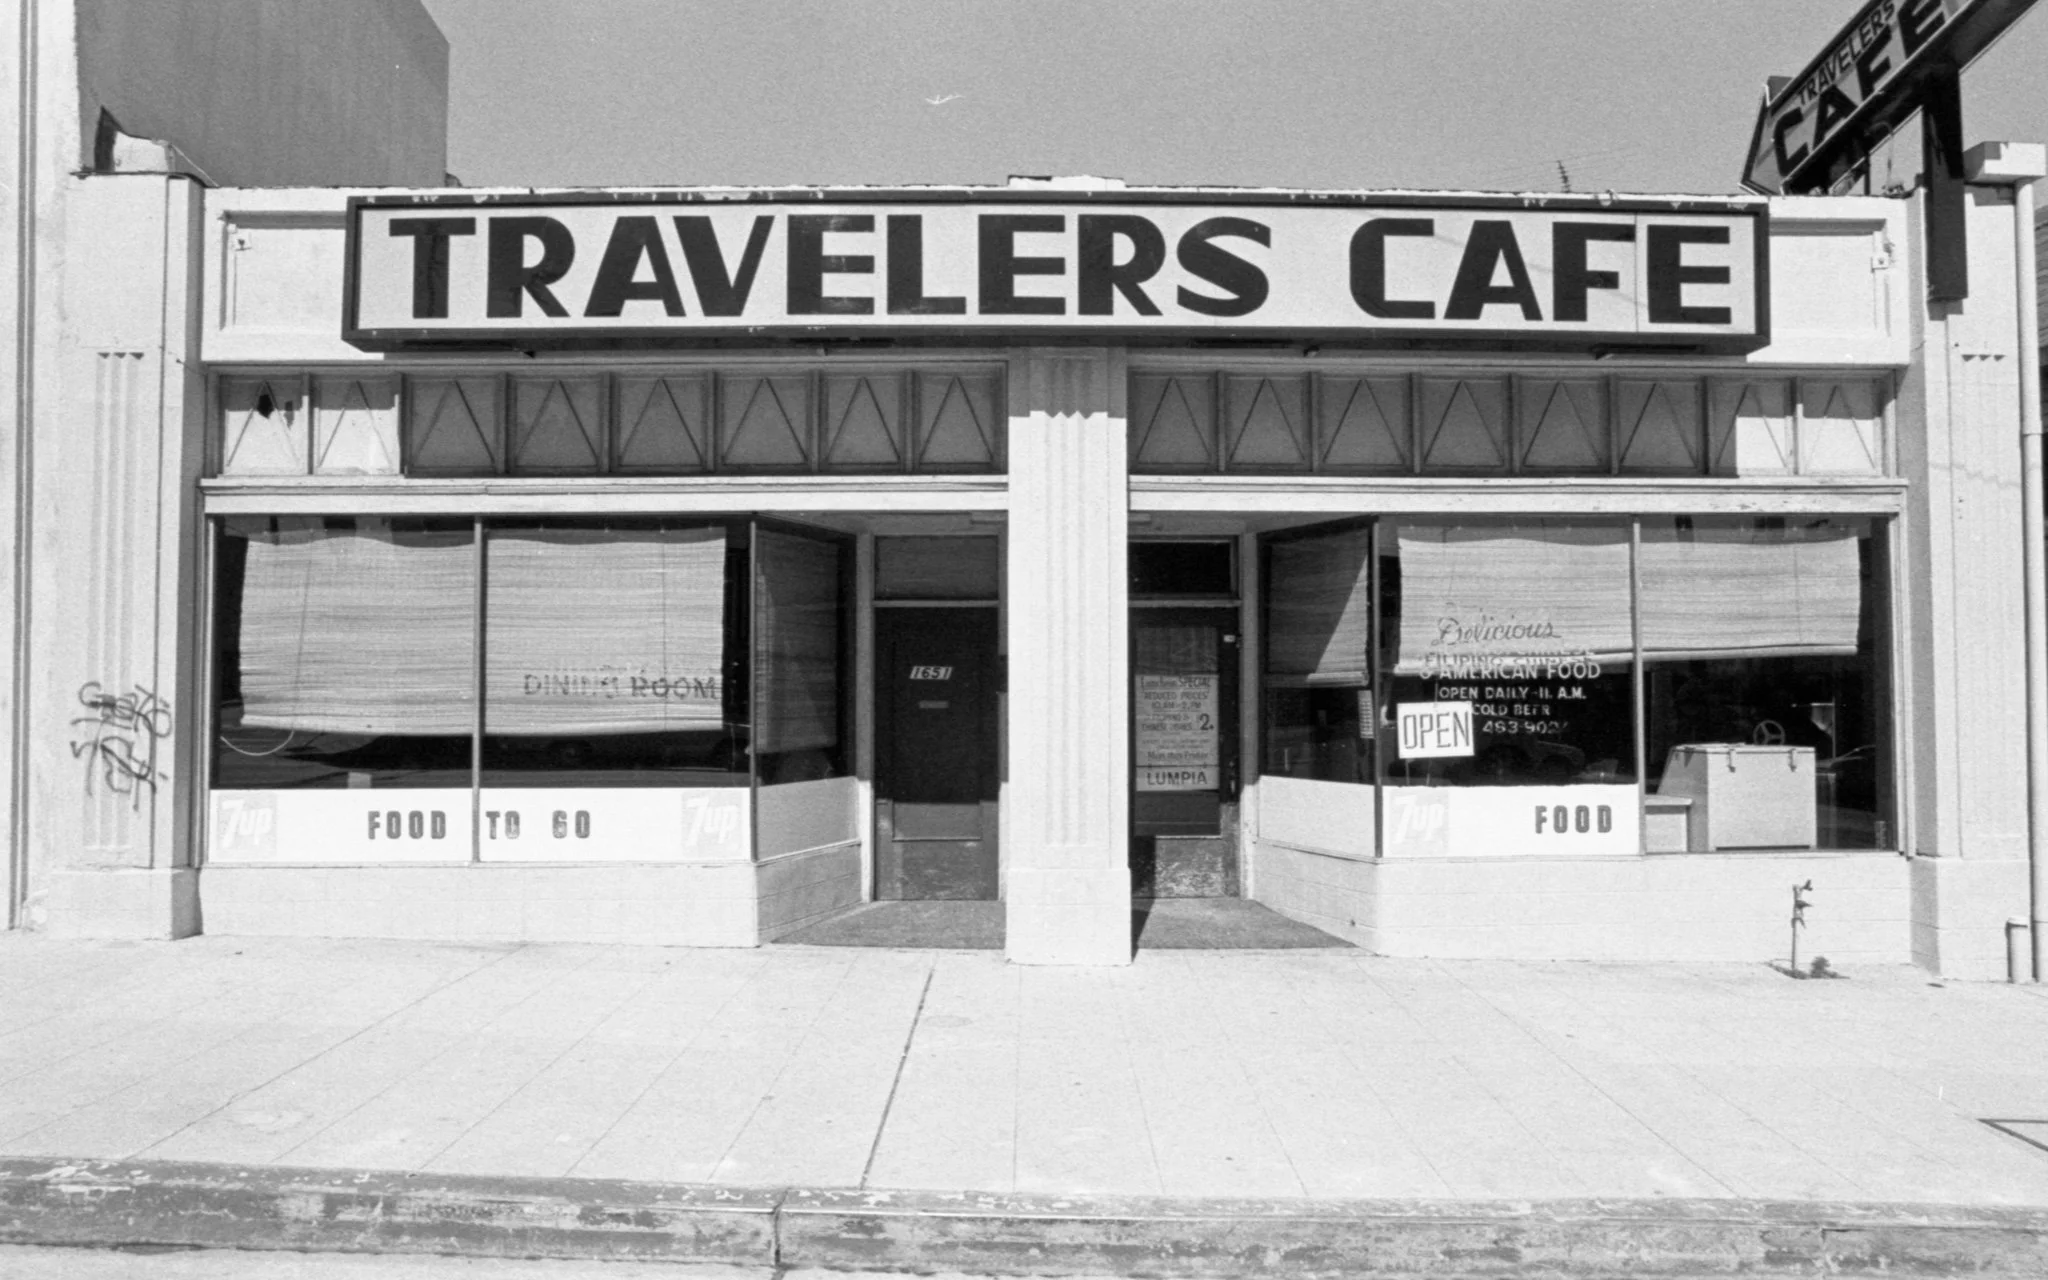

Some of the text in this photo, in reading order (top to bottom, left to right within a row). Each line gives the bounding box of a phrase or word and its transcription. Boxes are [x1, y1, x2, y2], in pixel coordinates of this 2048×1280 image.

[1798, 0, 1895, 105] TRAVELERS
[1773, 0, 1947, 177] CAFE
[389, 214, 1733, 325] TRAVELERS CAFE
[913, 667, 950, 679] 1651
[1439, 663, 1538, 680] AMERICAN
[1547, 662, 1601, 680] FOOD
[630, 675, 717, 700] ROOM
[1439, 686, 1479, 699] OPEN
[1485, 686, 1529, 699] DAILY
[1472, 703, 1508, 716] COLD
[1403, 711, 1470, 749] OPEN
[1147, 771, 1208, 786] LUMPIA
[367, 810, 591, 840] FOOD TO GO
[1535, 805, 1612, 834] FOOD
